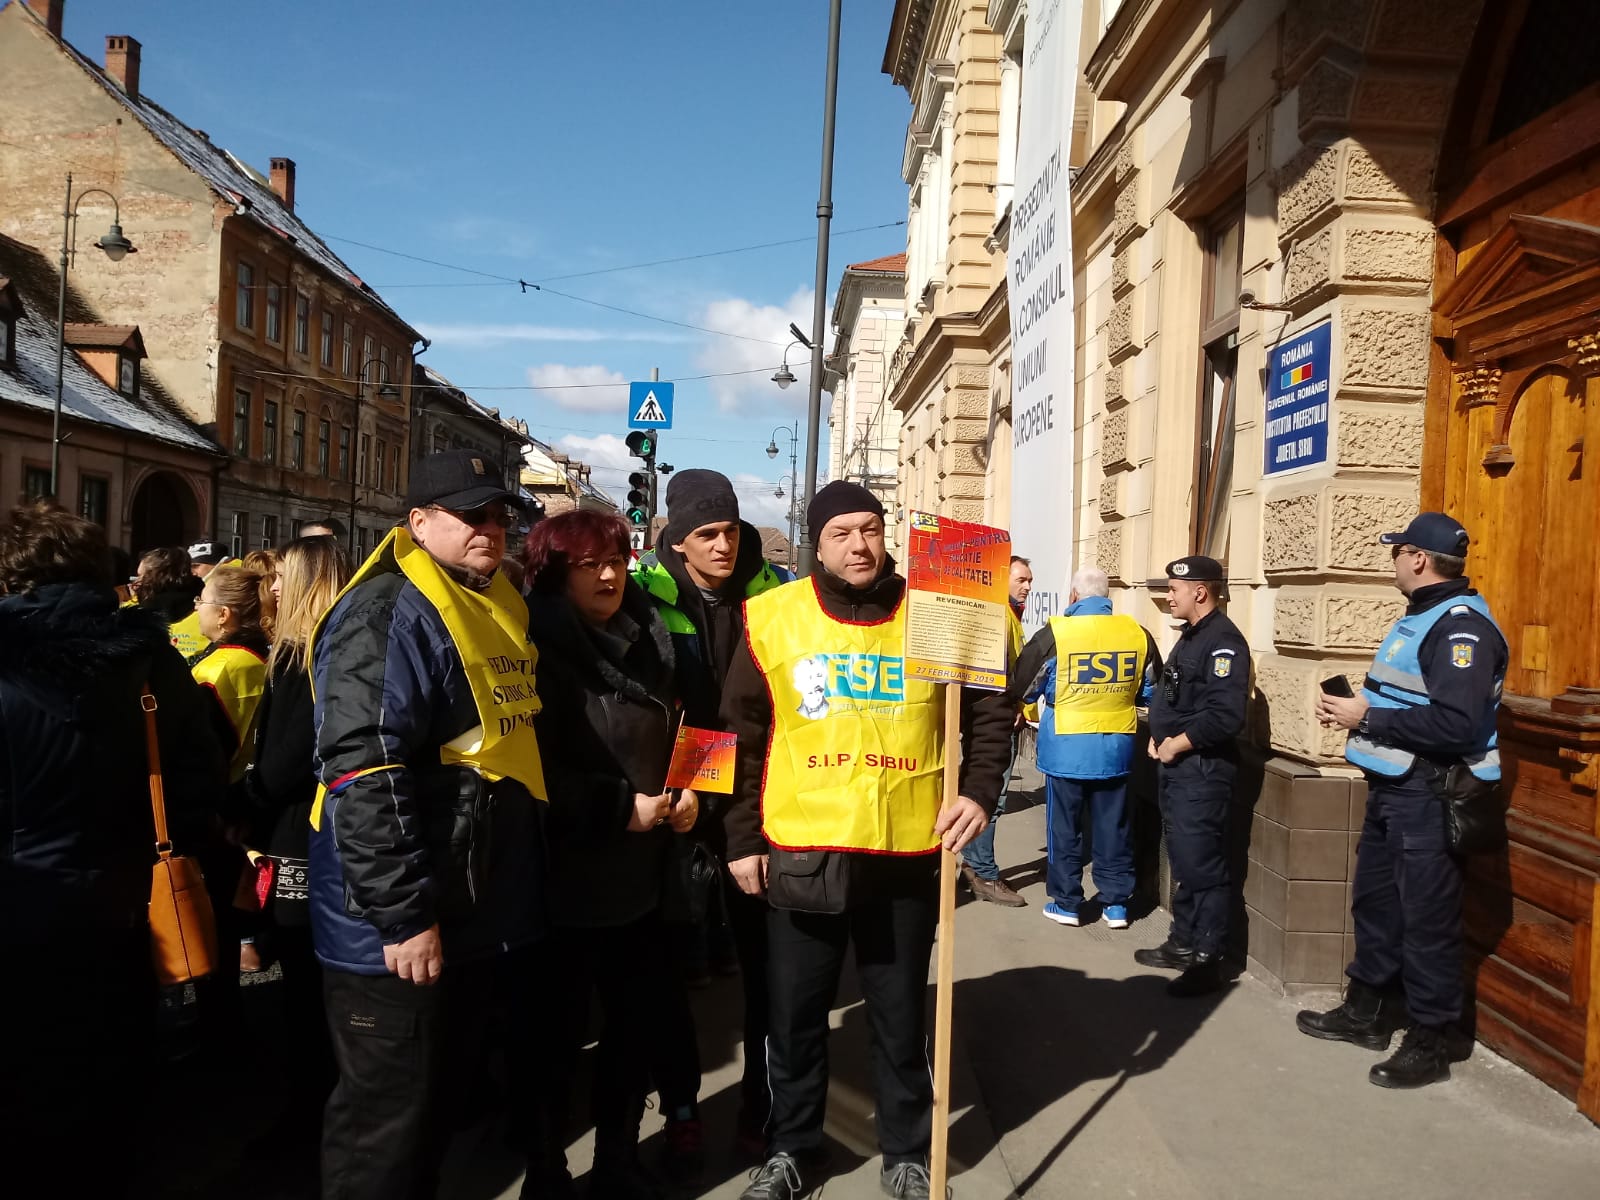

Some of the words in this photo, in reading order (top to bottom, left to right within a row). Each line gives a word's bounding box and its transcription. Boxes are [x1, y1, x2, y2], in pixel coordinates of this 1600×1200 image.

[1015, 208, 1056, 290] ROMÂNIEI
[1020, 262, 1065, 337] CONSILIUL
[1018, 337, 1047, 392] UNIUNII
[1281, 340, 1313, 368] ROMÂNIA
[1267, 391, 1296, 411] GUVERNUL
[1297, 379, 1328, 401] ROMÂNIEI
[919, 513, 939, 526] FSE
[970, 532, 1011, 547] PENTRU
[952, 567, 993, 587] CALITATE!
[827, 657, 902, 694] FSE
[915, 666, 927, 675] 27
[928, 668, 972, 680] FEBRUARIE
[975, 675, 995, 683] 2019
[1069, 652, 1137, 684] FSE
[1070, 684, 1099, 695] Spiru
[807, 753, 857, 769] S.I.P.
[865, 753, 917, 772] SIBIU
